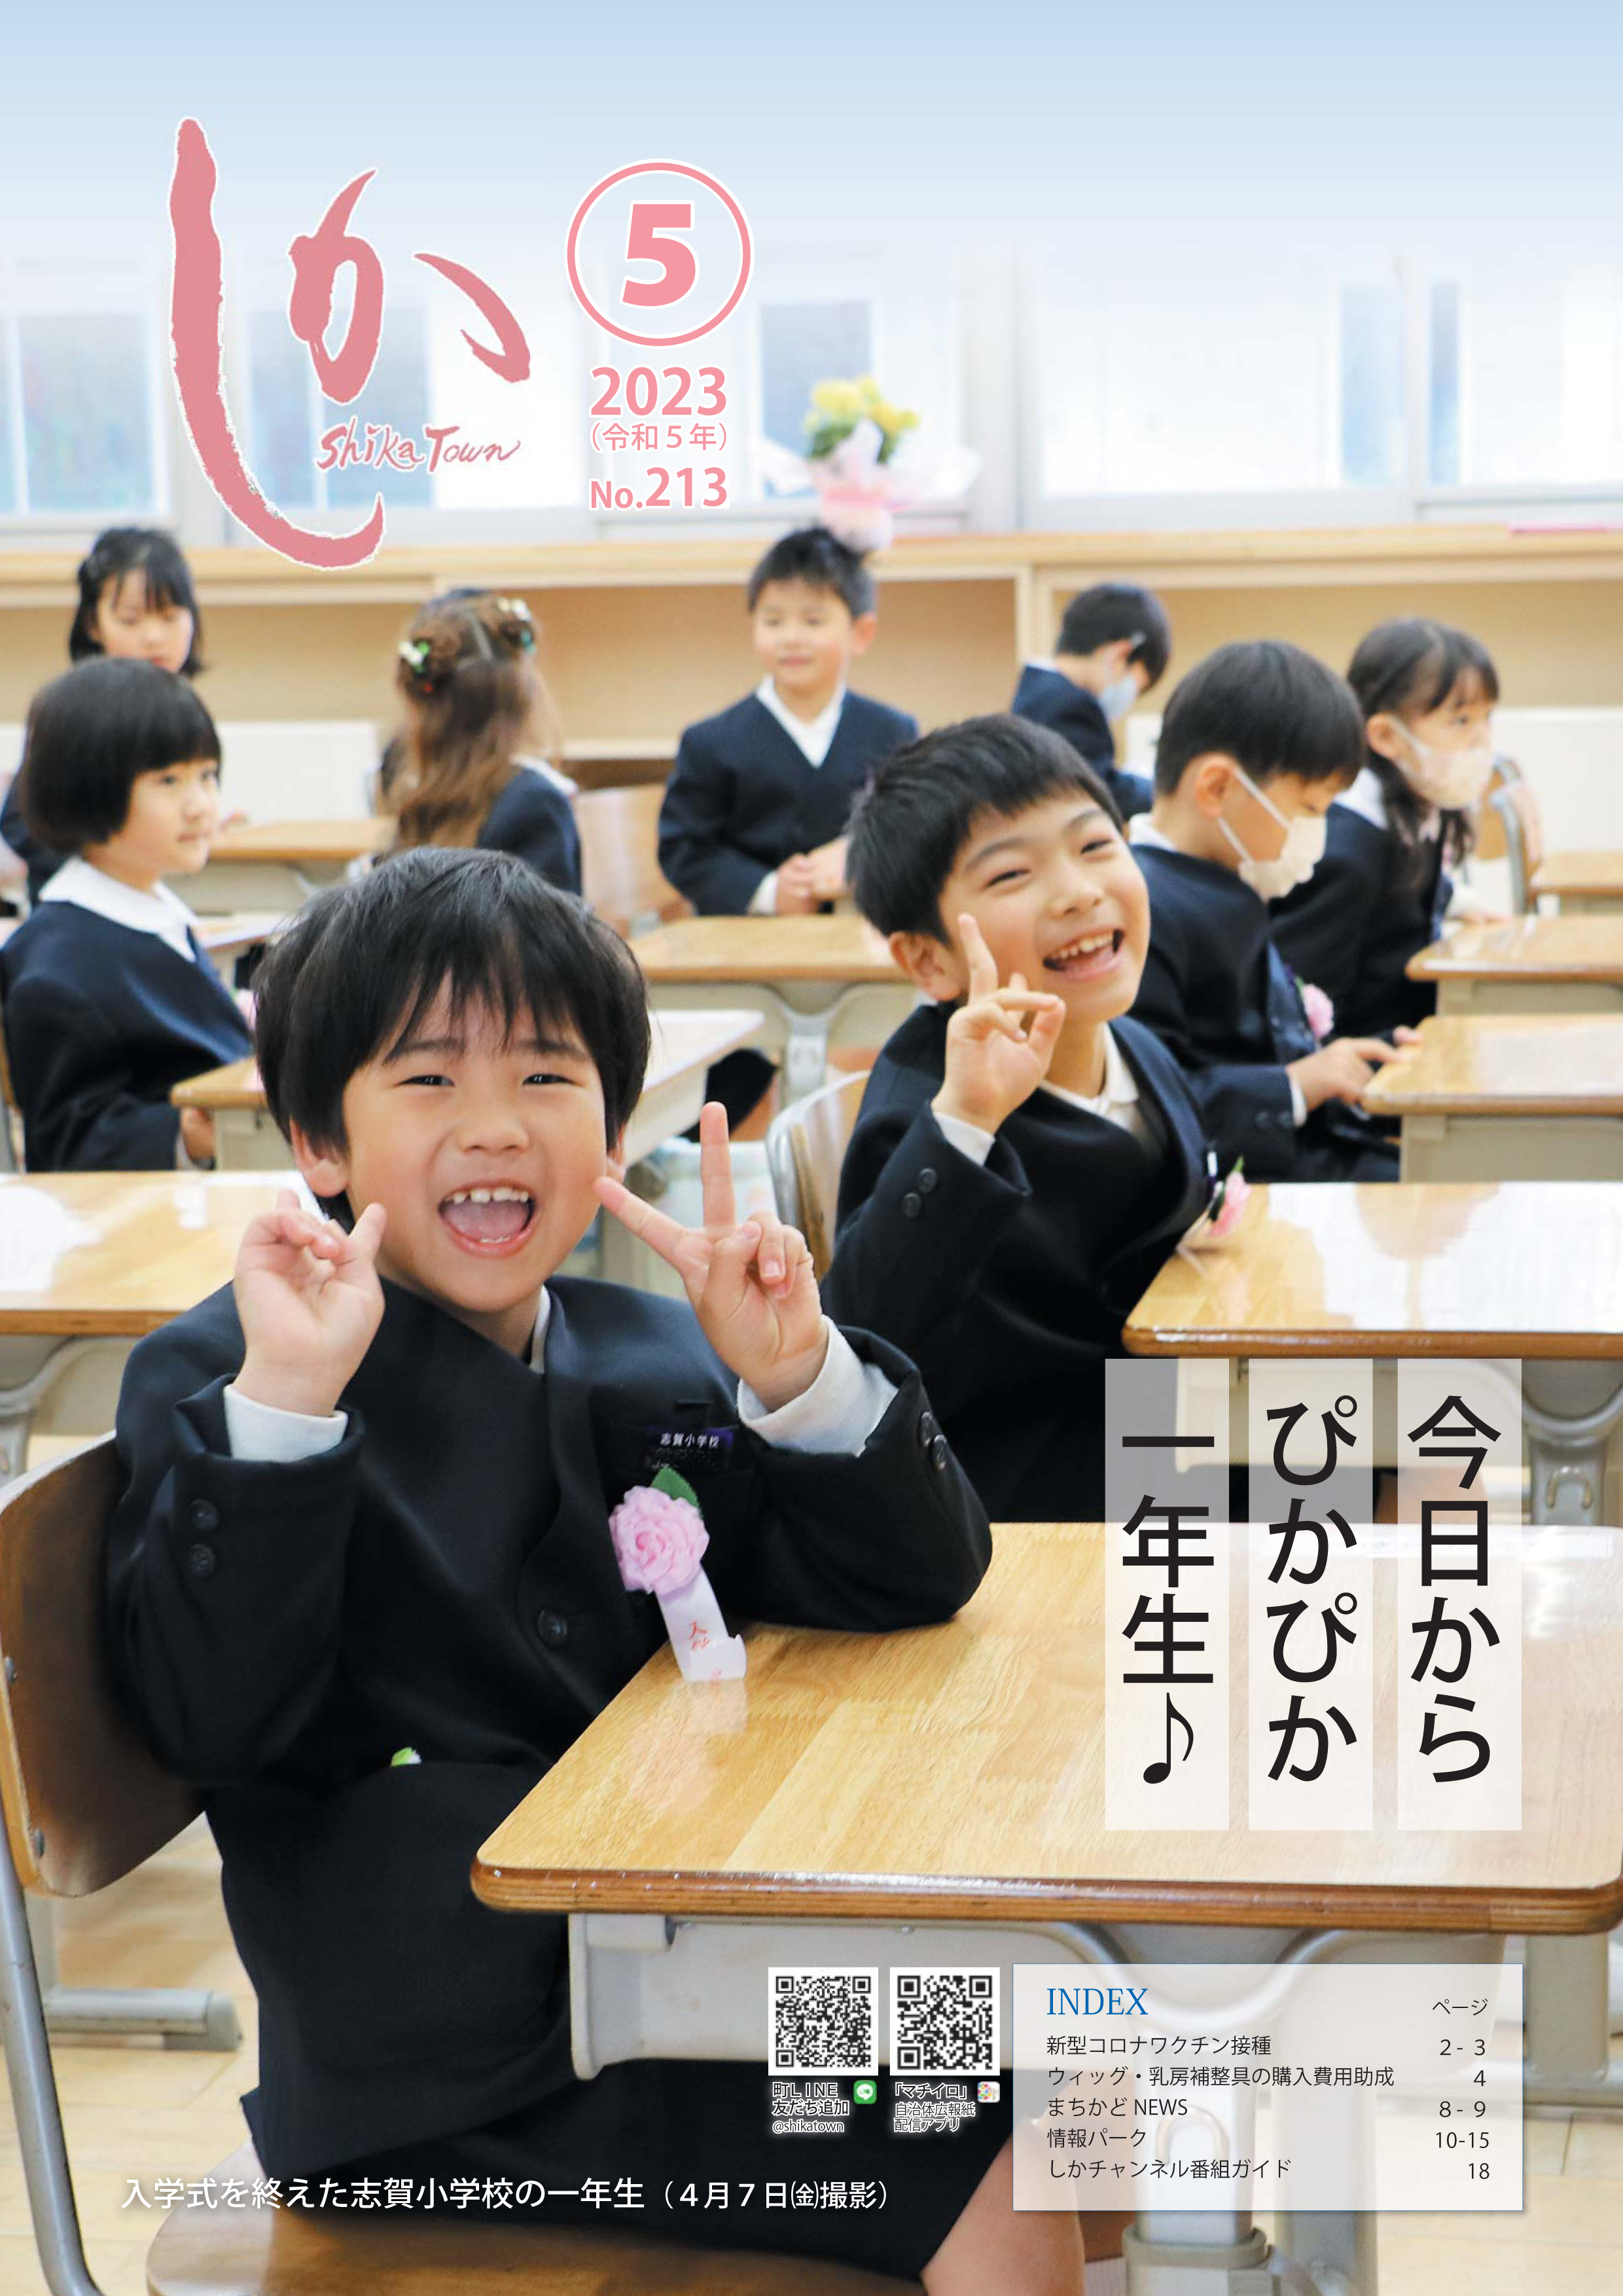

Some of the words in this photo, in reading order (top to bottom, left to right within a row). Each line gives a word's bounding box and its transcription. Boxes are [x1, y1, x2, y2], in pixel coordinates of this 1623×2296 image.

[660, 1431, 720, 1448] 志賀小学校
